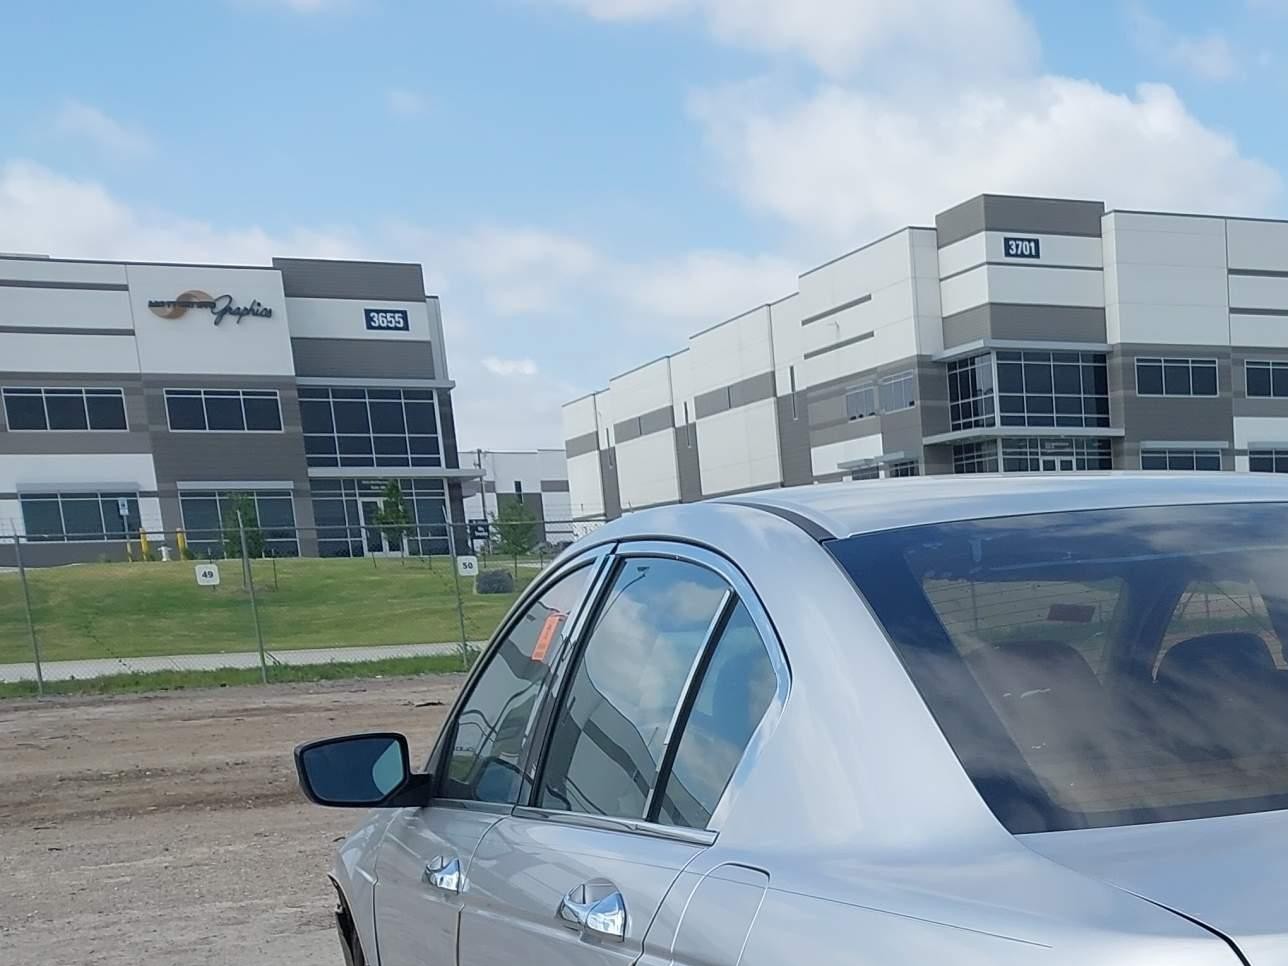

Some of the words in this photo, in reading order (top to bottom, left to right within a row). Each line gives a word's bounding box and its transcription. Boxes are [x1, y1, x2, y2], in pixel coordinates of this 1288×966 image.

[1009, 240, 1036, 256] 3701
[211, 294, 273, 326] Graphics
[370, 312, 404, 328] 3655
[462, 561, 474, 570] 50
[201, 570, 214, 579] 49
